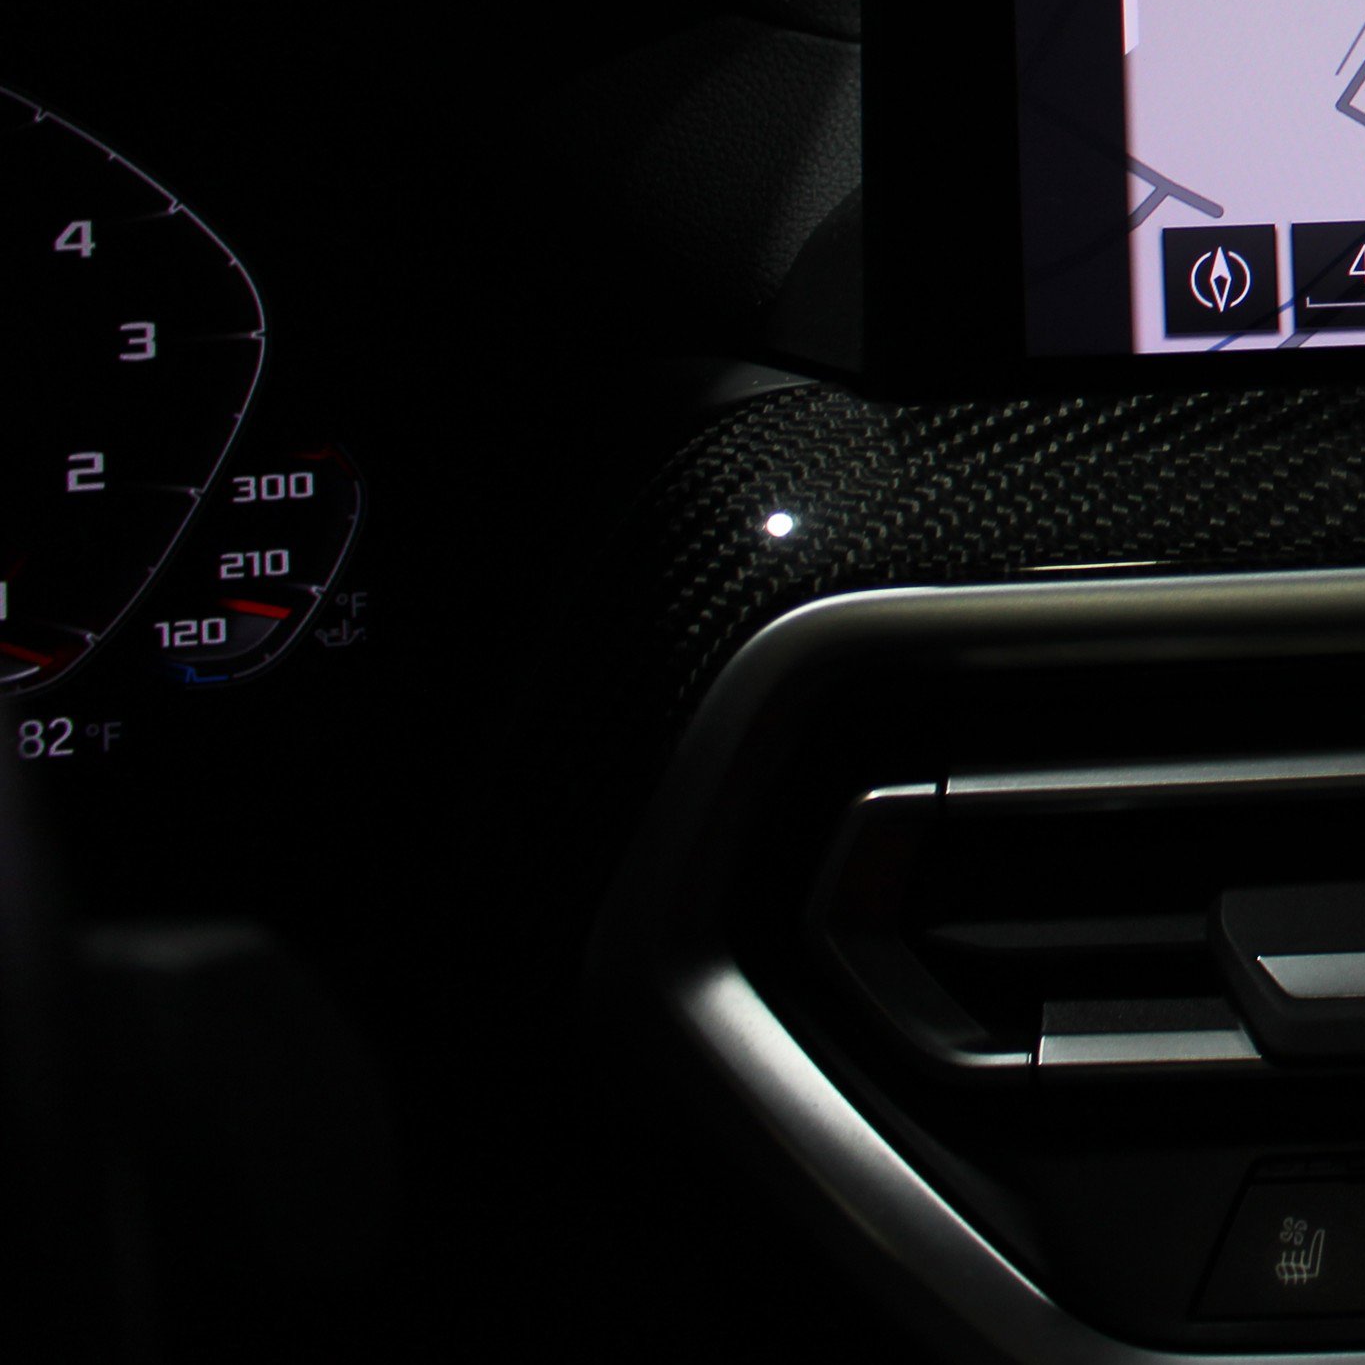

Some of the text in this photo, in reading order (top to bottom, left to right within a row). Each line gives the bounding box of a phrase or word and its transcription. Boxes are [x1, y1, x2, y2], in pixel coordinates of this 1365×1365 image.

[55, 220, 97, 258] 4
[119, 322, 156, 361] 3
[67, 452, 105, 492] 2
[232, 472, 314, 503] 300
[219, 549, 290, 578] 210
[154, 618, 227, 647] 120
[18, 717, 75, 759] 82
